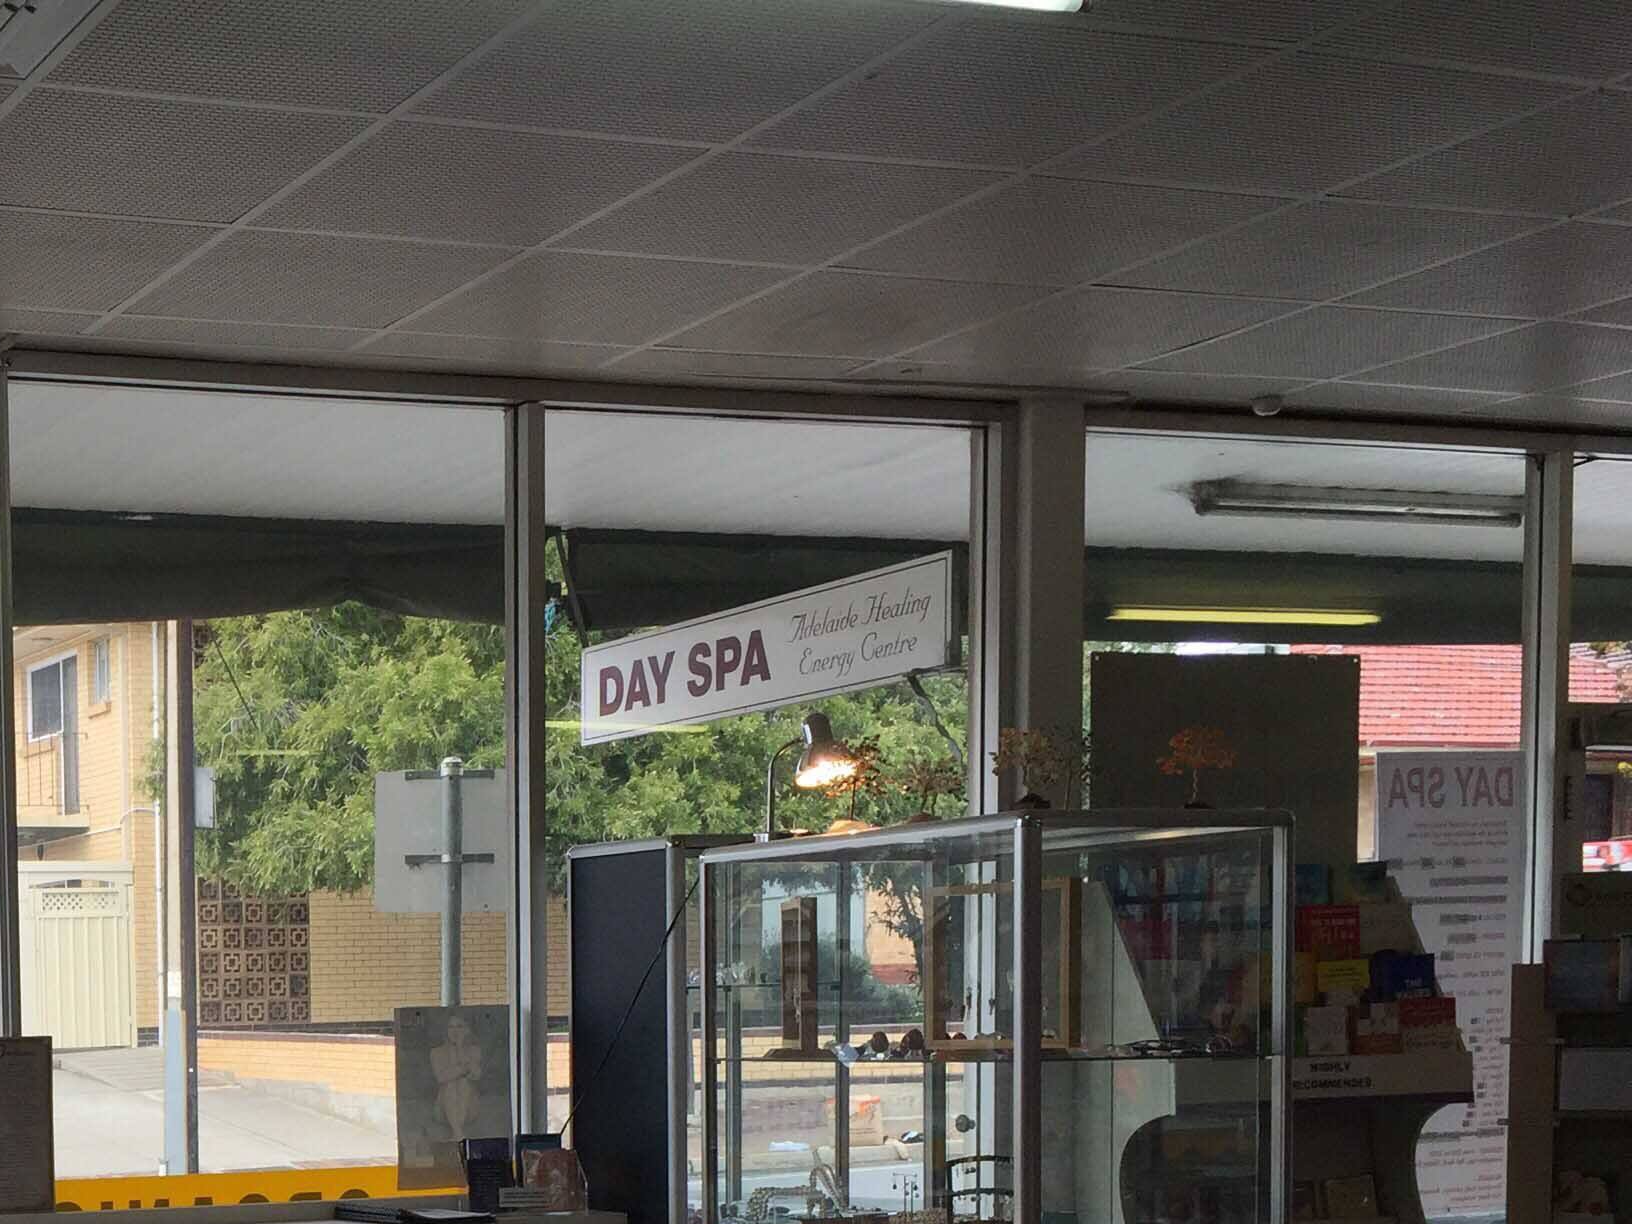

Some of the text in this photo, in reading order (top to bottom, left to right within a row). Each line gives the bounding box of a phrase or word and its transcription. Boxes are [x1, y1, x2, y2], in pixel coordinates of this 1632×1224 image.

[788, 588, 932, 642] Adelaide Healing
[599, 630, 771, 717] DAY SPA
[799, 631, 918, 678] Energy Centre
